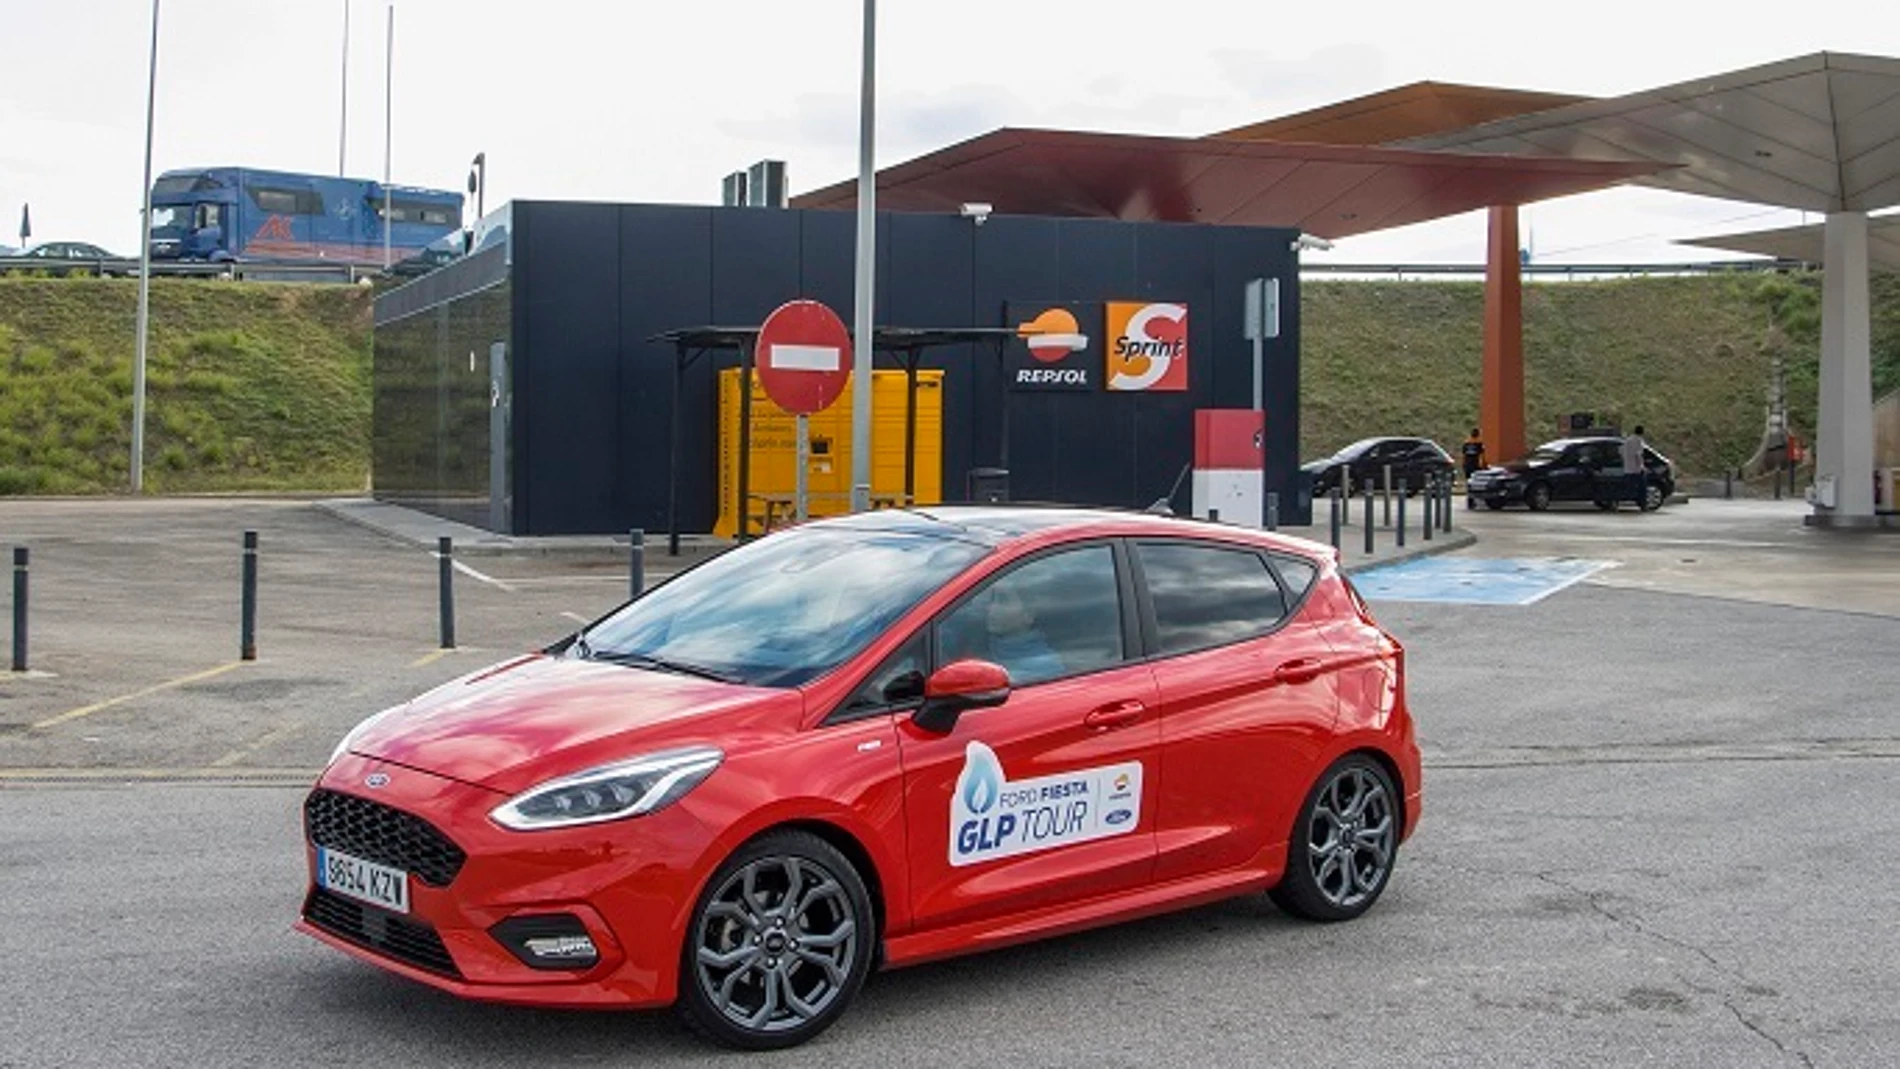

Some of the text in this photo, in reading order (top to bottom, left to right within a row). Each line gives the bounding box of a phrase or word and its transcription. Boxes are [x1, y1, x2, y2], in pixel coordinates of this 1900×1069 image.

[1115, 336, 1184, 362] Sprint
[1016, 369, 1087, 384] REPSOL
[1000, 781, 1089, 808] FORD FIESTA
[958, 801, 1087, 855] GLP TOUR
